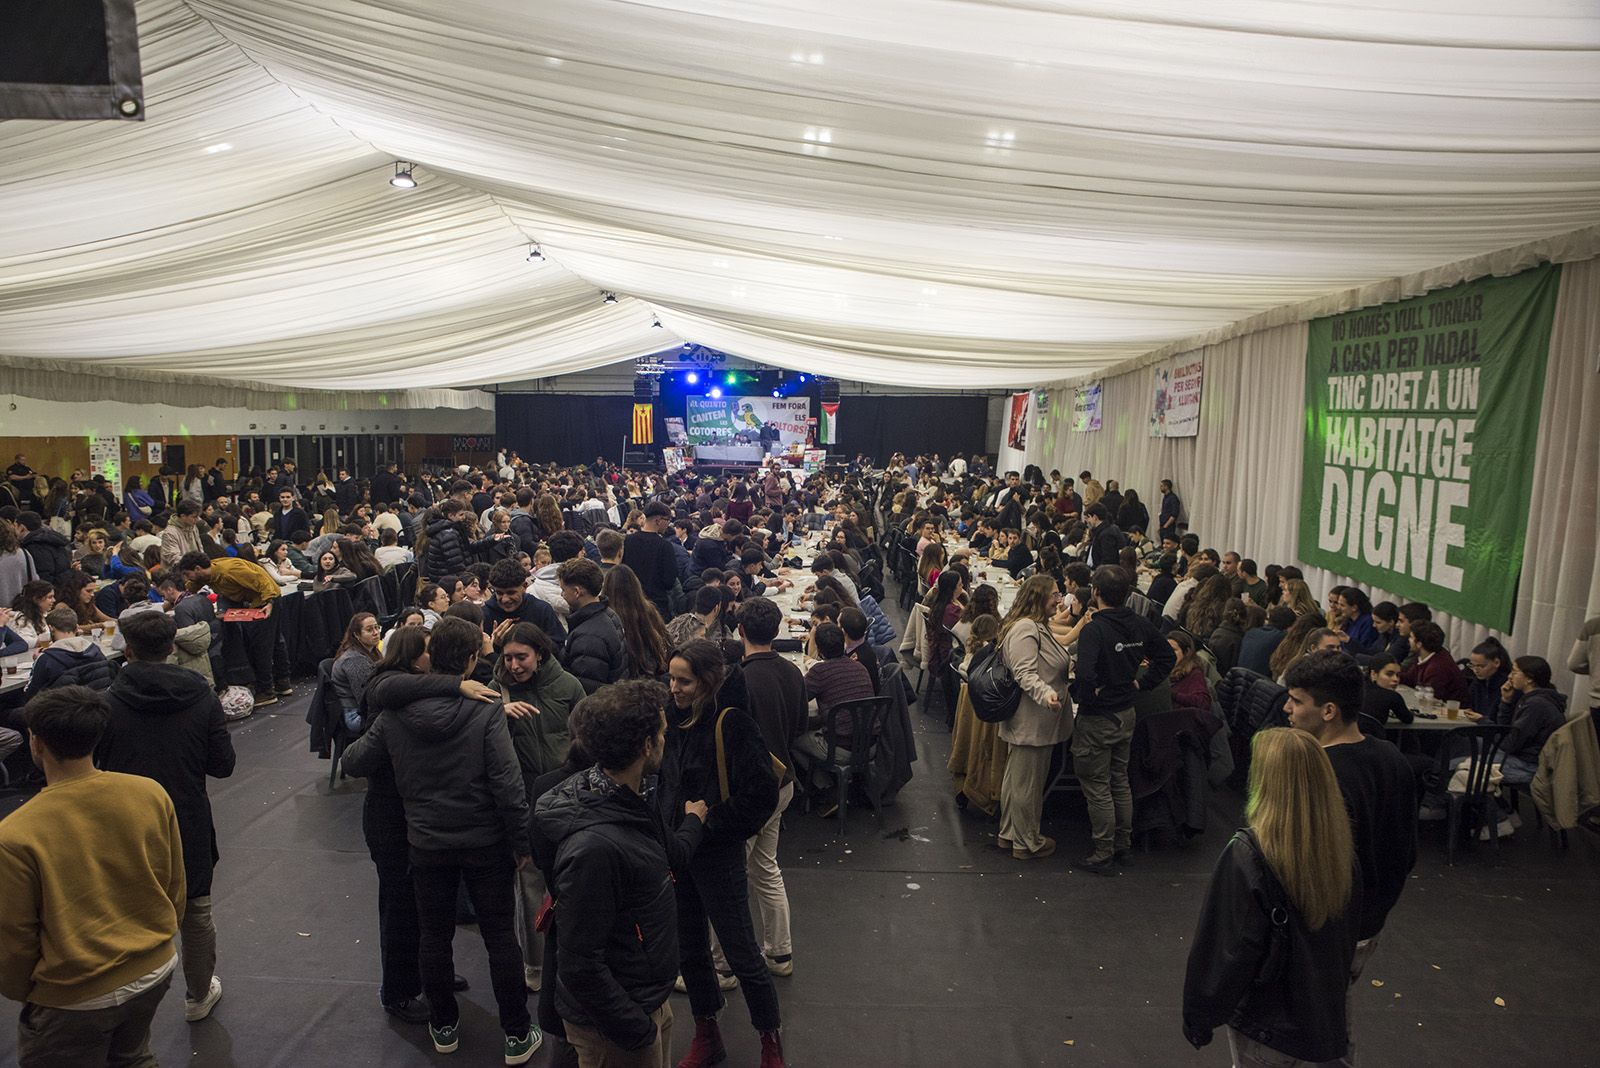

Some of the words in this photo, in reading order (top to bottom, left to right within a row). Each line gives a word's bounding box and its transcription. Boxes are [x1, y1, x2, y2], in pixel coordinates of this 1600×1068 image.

[1332, 319, 1346, 342] NO
[1349, 308, 1391, 339] NOMÉS
[1395, 305, 1425, 333] VULL
[1428, 294, 1484, 329] TORNAR
[1329, 346, 1339, 374] A
[1343, 341, 1382, 373] CASA
[1387, 336, 1419, 369] PER
[1423, 328, 1481, 367] NADAL
[700, 400, 727, 408] QUINTO
[772, 402, 787, 410] FEM
[788, 402, 806, 410] FORA
[1328, 374, 1366, 410] TINC
[1370, 370, 1424, 410] DRET
[1424, 370, 1440, 410] A
[1447, 367, 1481, 410] UN
[691, 409, 726, 424] CANTEM
[1324, 416, 1477, 481] HABITATGE
[1318, 465, 1471, 593] DIGNE
